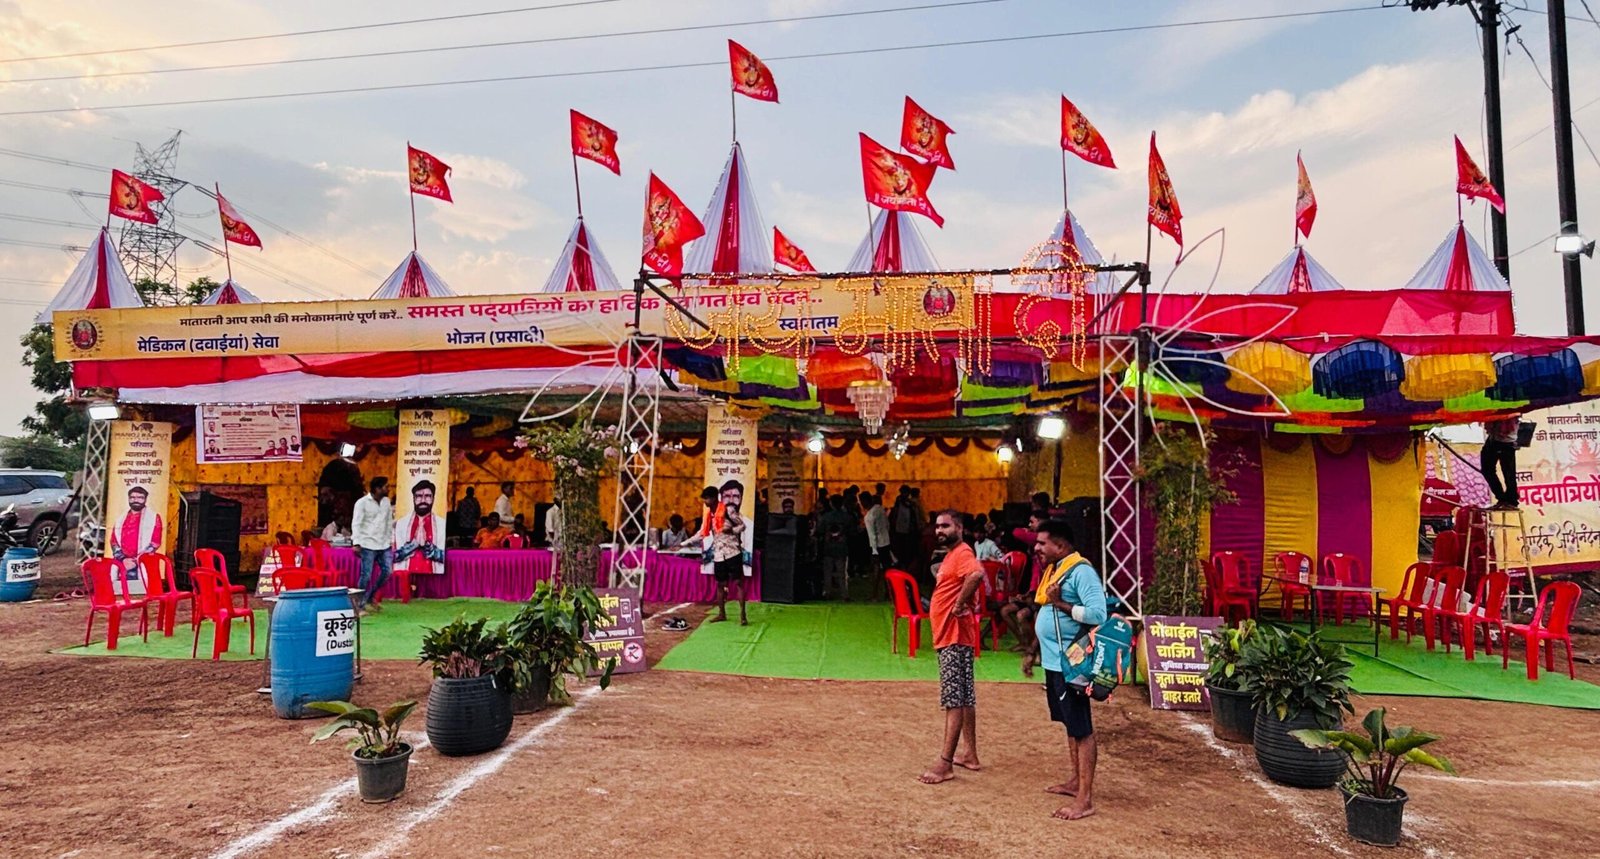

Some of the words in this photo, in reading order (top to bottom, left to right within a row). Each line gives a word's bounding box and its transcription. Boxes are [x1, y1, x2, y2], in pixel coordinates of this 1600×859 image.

[180, 314, 223, 326] मातारानी
[226, 316, 247, 325] आप
[250, 313, 271, 324] सभी
[274, 313, 288, 323] की
[292, 311, 354, 323] मनोकामनाएं
[356, 310, 377, 324] पूर्ण
[407, 304, 465, 318] समस्त
[137, 336, 186, 352] मेडिकल
[190, 333, 249, 353] (दवाईयां)
[252, 332, 280, 348] सेवा
[447, 328, 486, 344] भोजन
[1547, 412, 1583, 425] मातारानी
[1536, 429, 1548, 441] की
[1549, 428, 1598, 442] मनोकामनाएं
[1154, 673, 1174, 688] जूता
[1176, 674, 1204, 686] चप्पल
